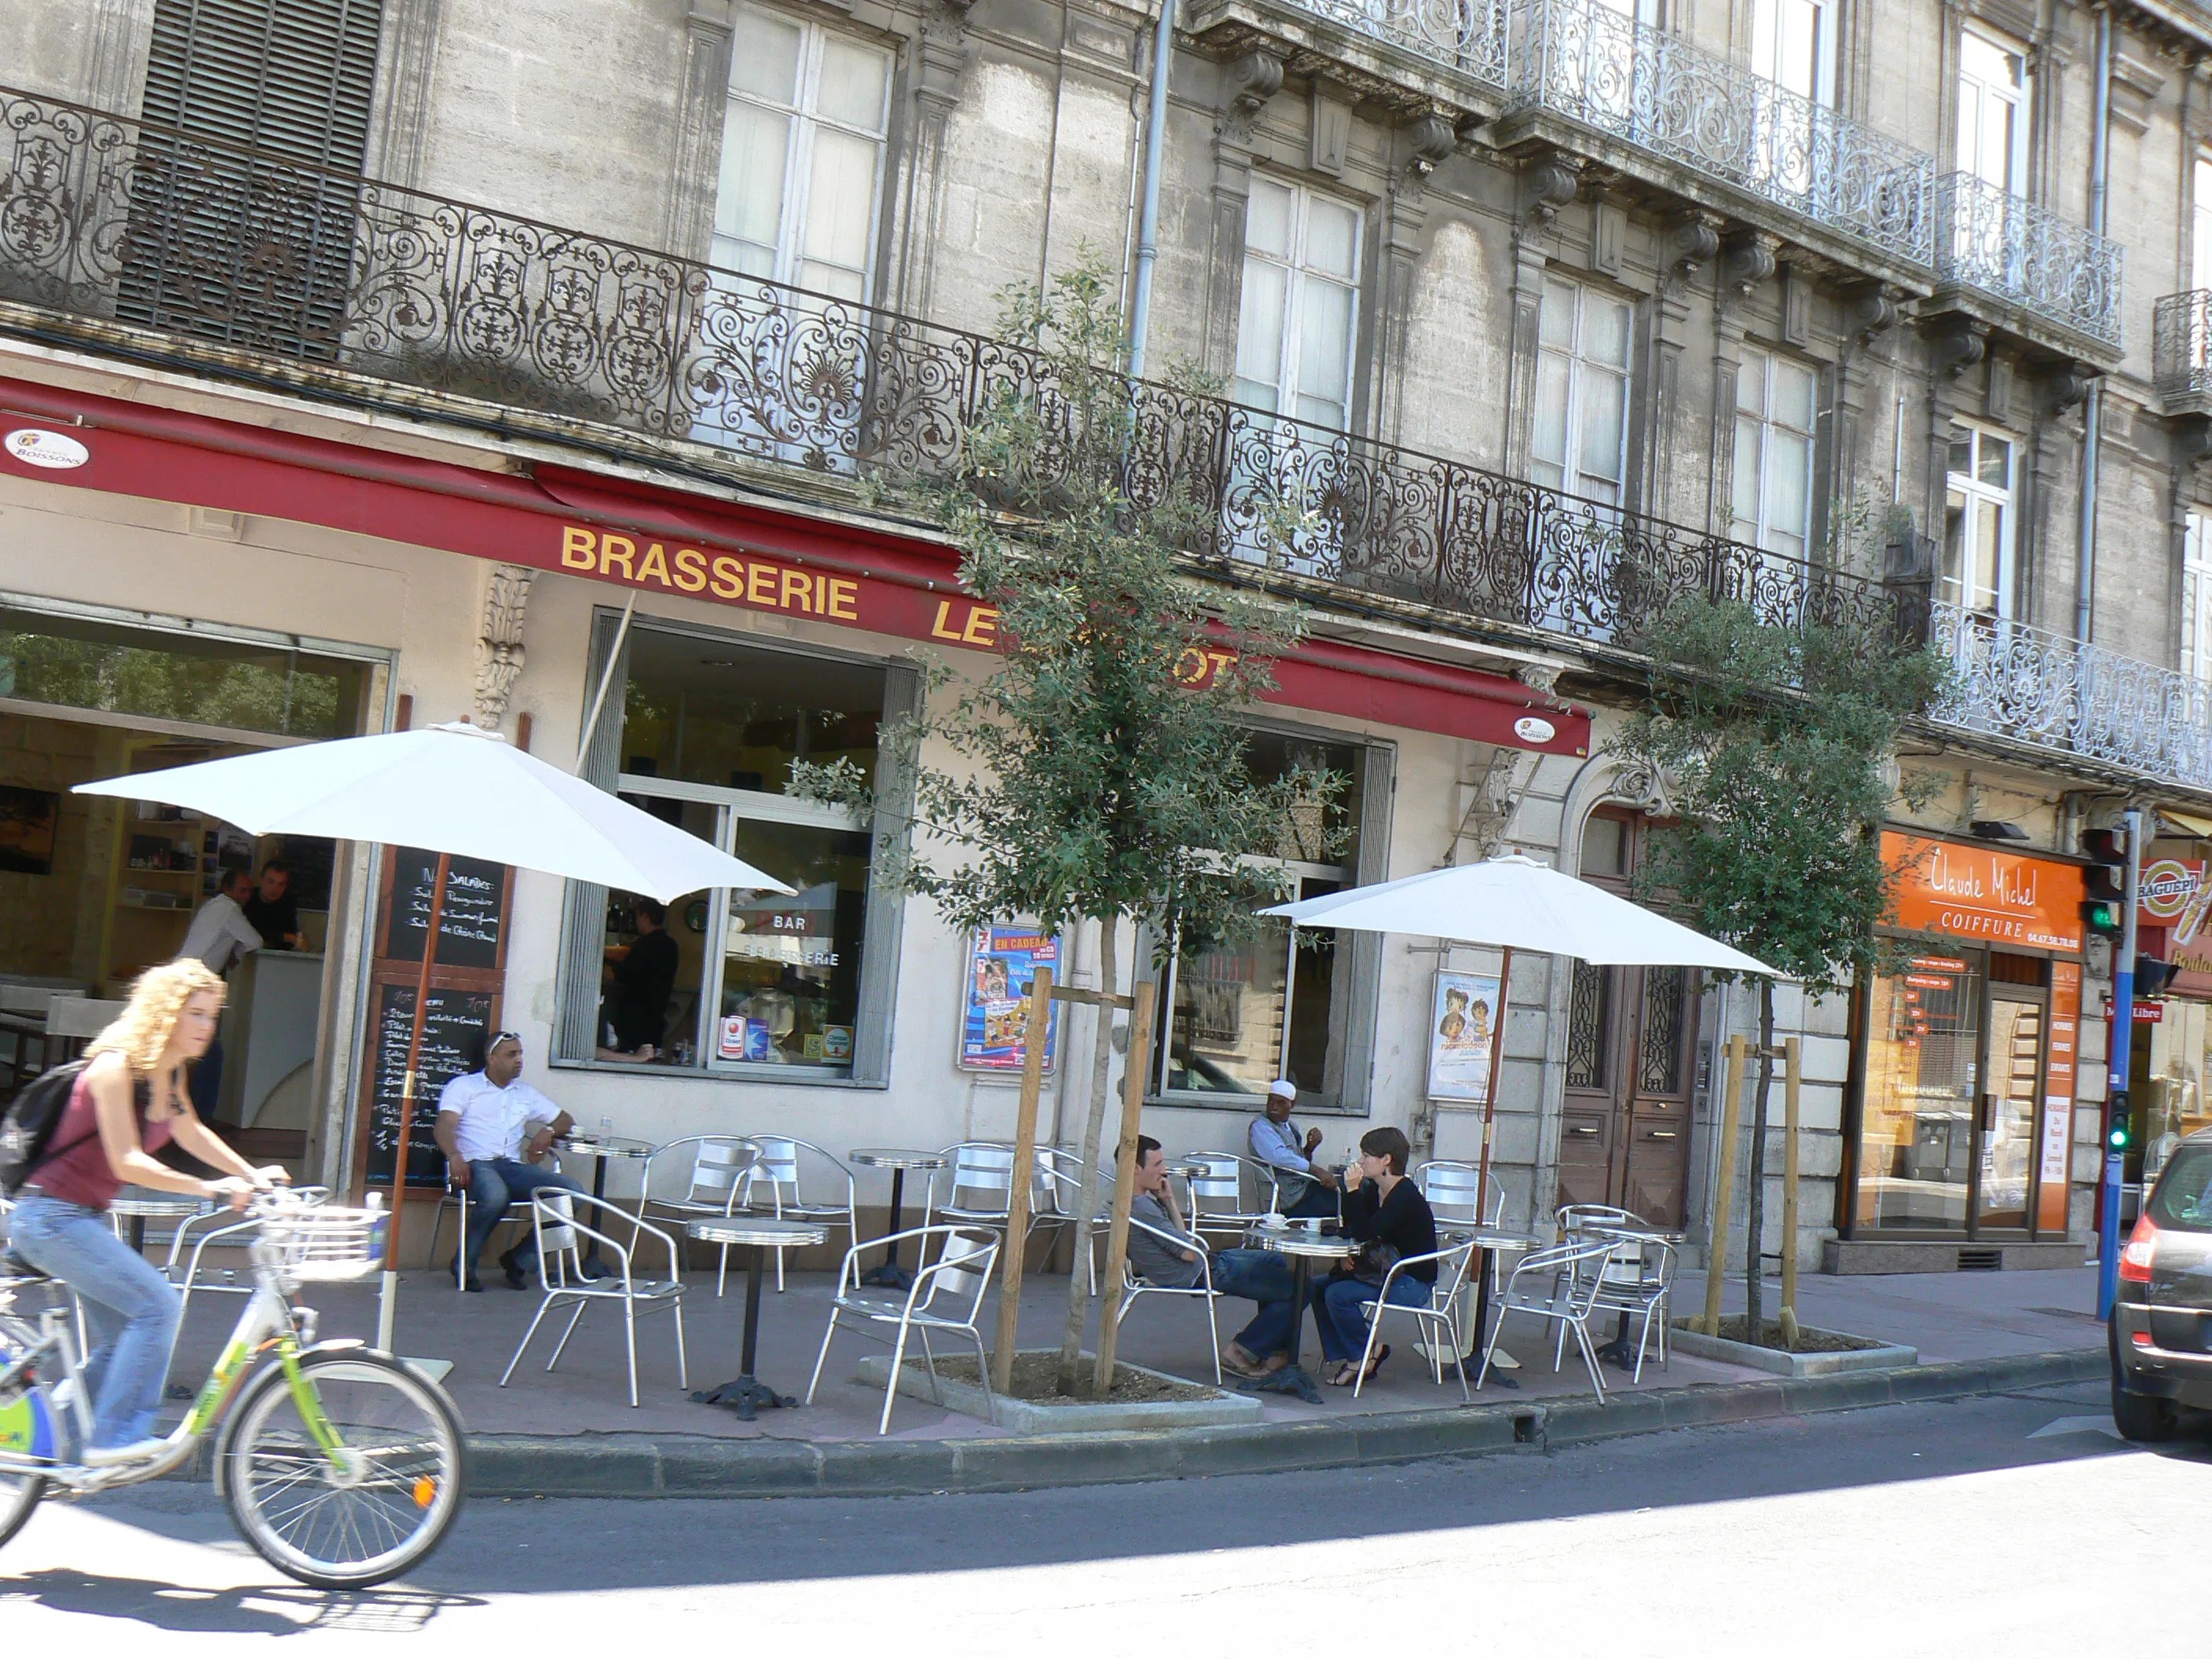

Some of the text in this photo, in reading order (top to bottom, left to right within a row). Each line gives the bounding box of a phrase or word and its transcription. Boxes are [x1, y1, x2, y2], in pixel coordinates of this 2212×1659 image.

[16, 449, 80, 464] BOISSONS
[562, 526, 1002, 646] BRASSERIE LE
[1931, 848, 2036, 906] Claude Michel
[773, 915, 806, 930] BAR
[1941, 911, 2024, 938] COIFFURE
[994, 939, 1007, 950] EN
[2133, 1008, 2160, 1019] Libre
